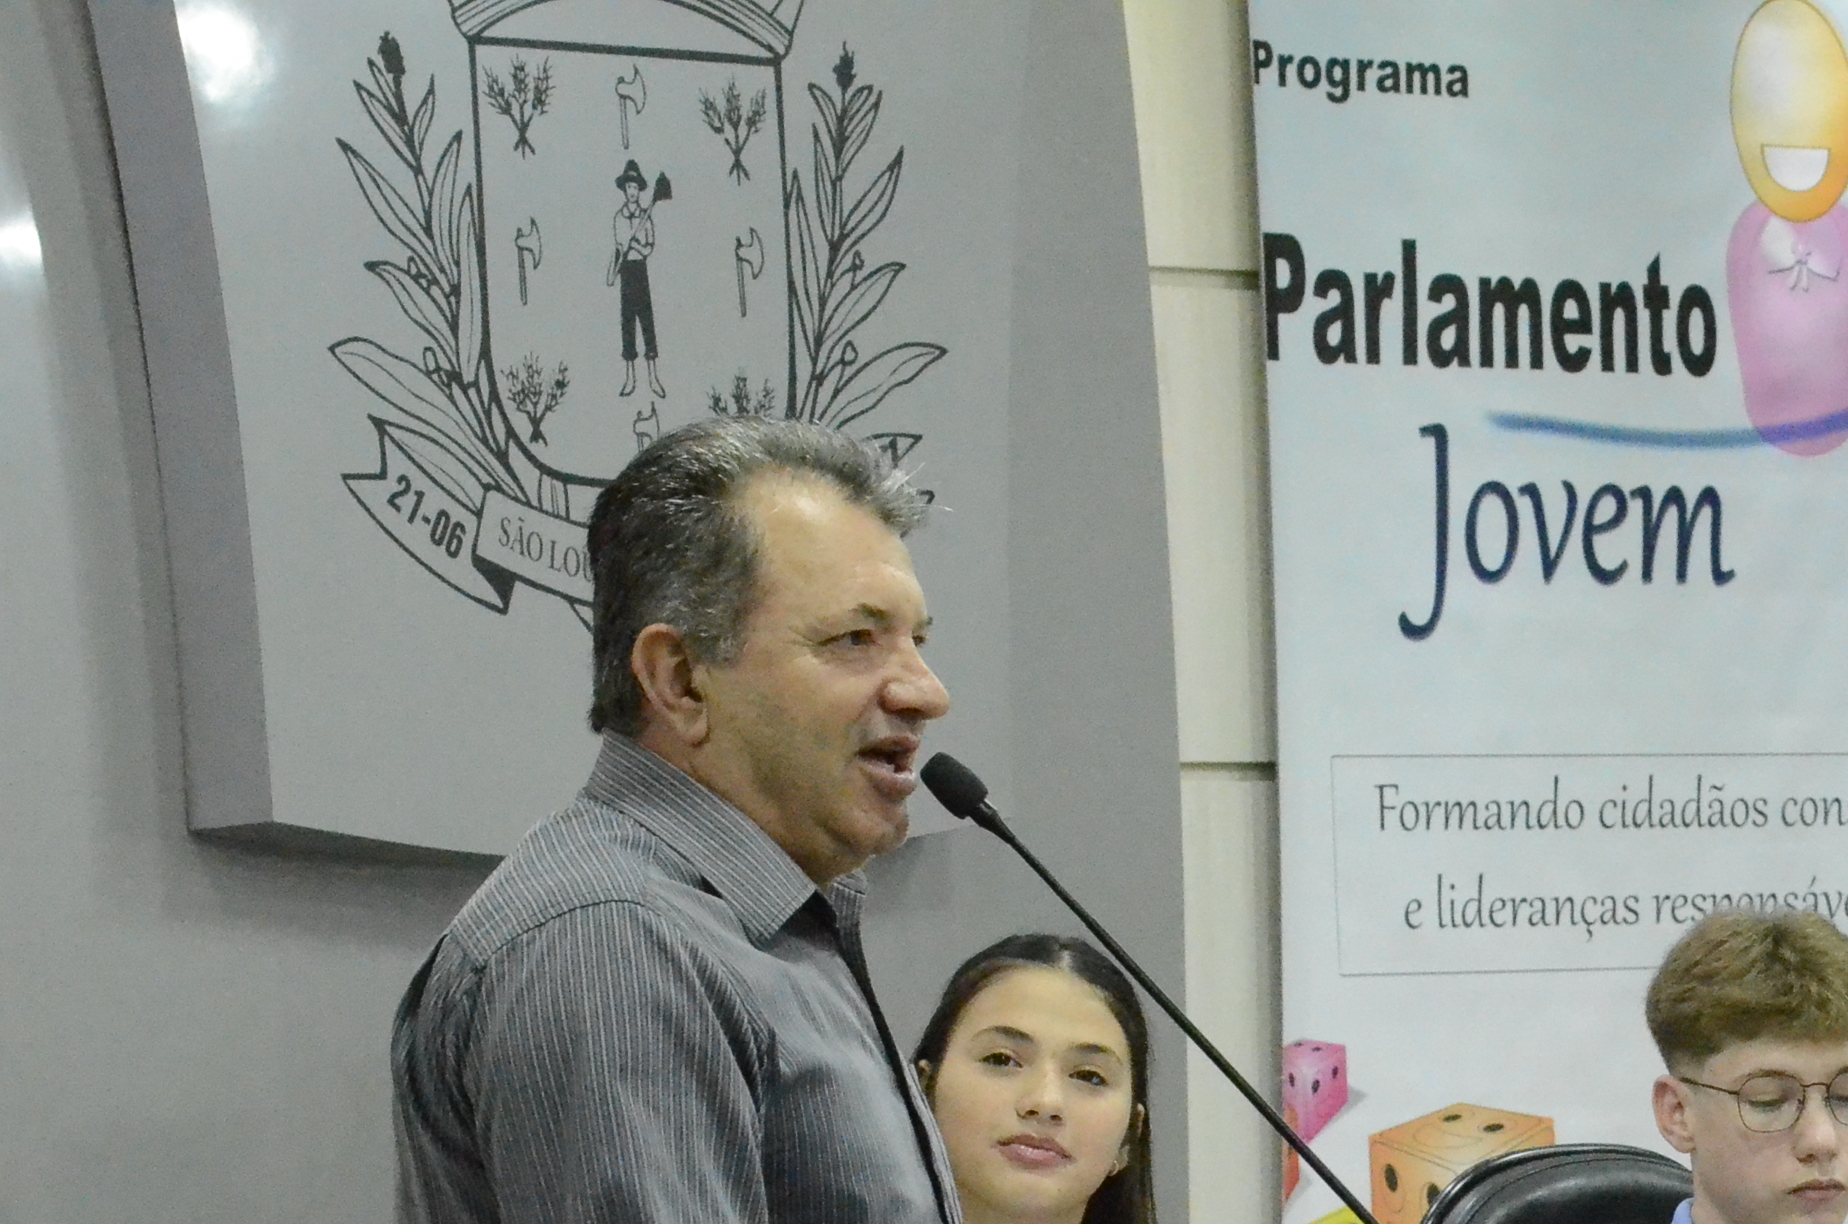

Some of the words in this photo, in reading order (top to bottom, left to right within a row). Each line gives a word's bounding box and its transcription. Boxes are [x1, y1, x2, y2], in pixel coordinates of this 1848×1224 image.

[1252, 39, 1470, 103] Programa
[1263, 232, 1717, 378] Parlamento
[386, 473, 468, 559] 21-06
[497, 515, 544, 562] SÃO
[1398, 422, 1735, 640] Jovem
[1375, 775, 1586, 832] Formando
[1598, 773, 1770, 830] cidadãos
[1404, 898, 1423, 929] e
[1436, 873, 1641, 942] lideranças
